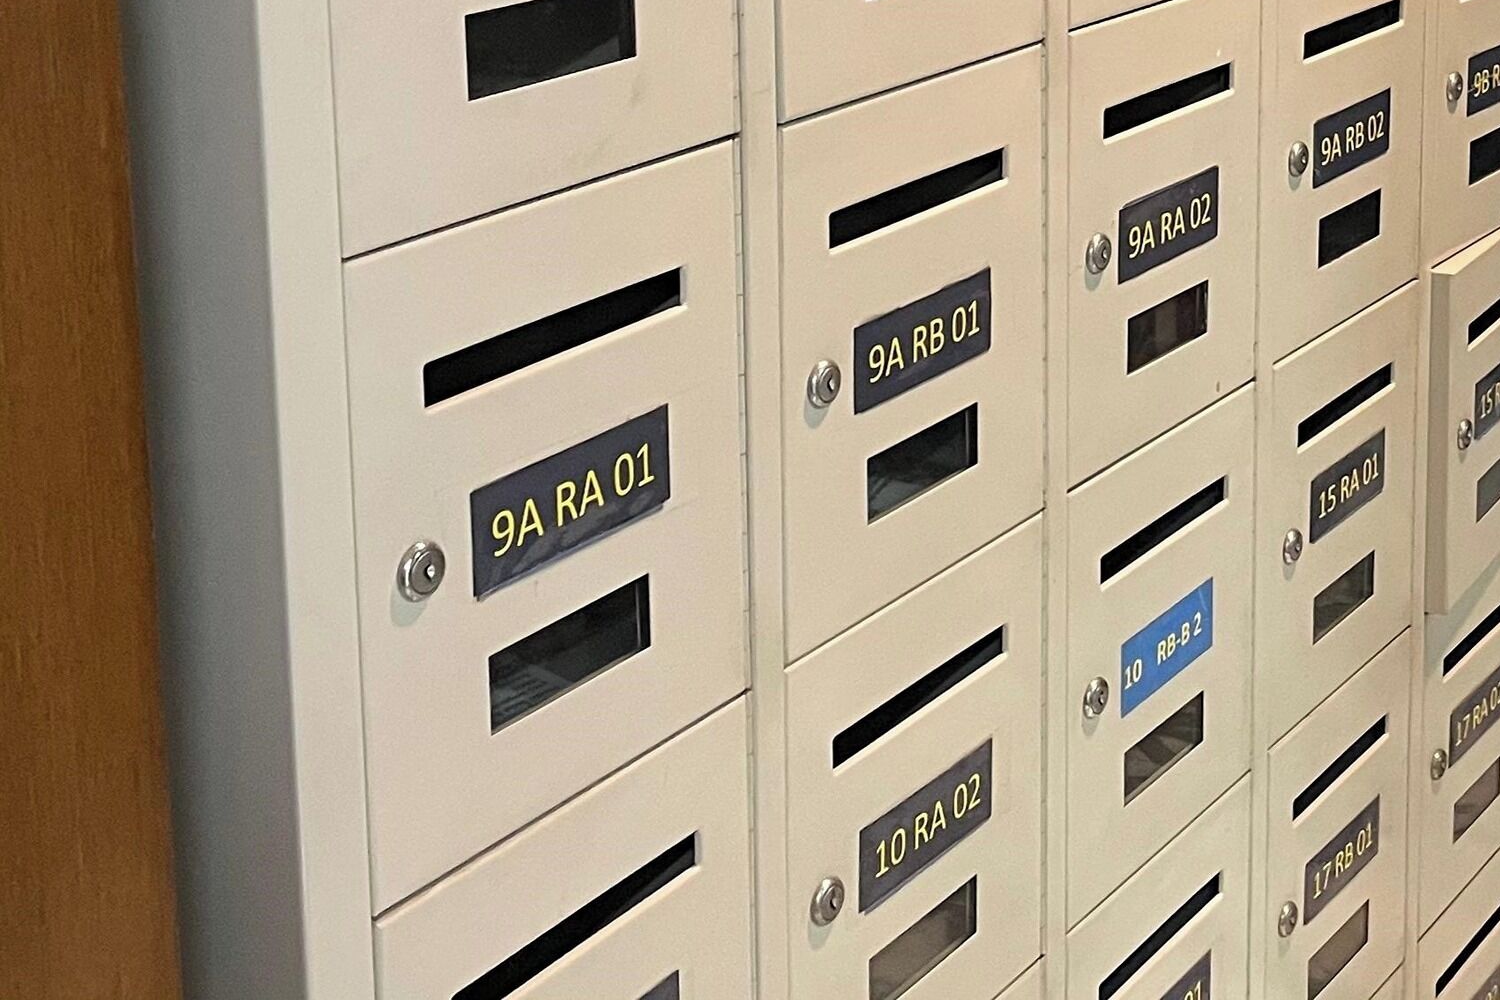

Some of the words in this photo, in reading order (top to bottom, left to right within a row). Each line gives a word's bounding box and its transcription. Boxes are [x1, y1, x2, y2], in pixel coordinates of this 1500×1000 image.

[1473, 69, 1491, 98] 9B
[1321, 133, 1342, 166] 9A
[1345, 121, 1365, 154] RB
[1367, 111, 1385, 142] 02
[1128, 220, 1155, 259] 9A
[1160, 206, 1186, 245] RA
[1190, 193, 1211, 229] 02
[868, 337, 905, 383] 9A
[913, 317, 945, 364] RB
[952, 300, 980, 343] 01
[1480, 391, 1494, 419] 15
[492, 498, 544, 557] 9A
[556, 469, 605, 527] RA
[614, 443, 655, 496] 01
[1318, 484, 1337, 519] 15
[1340, 468, 1360, 503] RA
[1362, 452, 1379, 485] 01
[1124, 658, 1143, 690] 10
[1157, 621, 1191, 666] RB-B
[1193, 611, 1202, 637] 2
[1455, 713, 1471, 747] 17
[1472, 697, 1492, 730] RA
[875, 827, 906, 878] 10
[914, 800, 947, 850] RA
[953, 773, 981, 819] 02
[1312, 860, 1332, 900] 17
[1335, 841, 1354, 879] RB
[1356, 822, 1373, 856] 01
